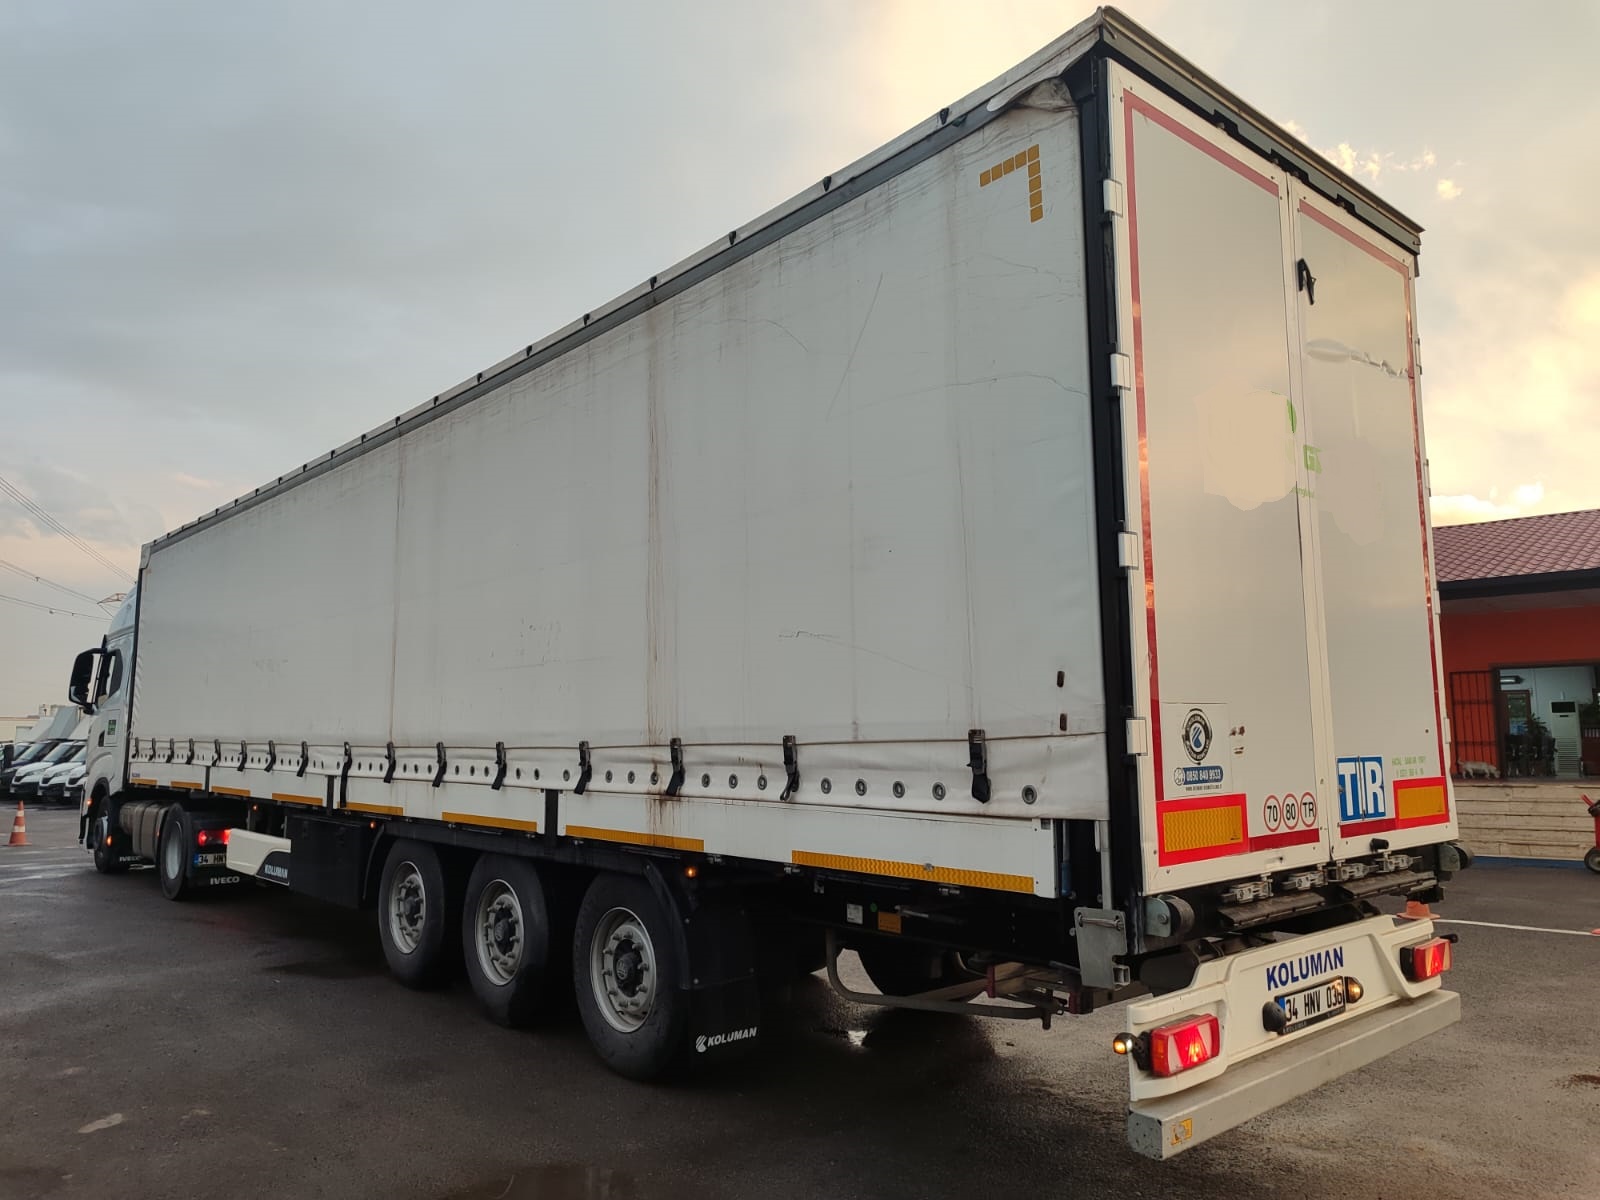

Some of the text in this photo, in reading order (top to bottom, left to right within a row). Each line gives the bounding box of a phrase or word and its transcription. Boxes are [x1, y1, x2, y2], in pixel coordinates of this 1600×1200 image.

[1338, 761, 1385, 817] TIR
[1267, 805, 1278, 823] 70
[1285, 803, 1296, 821] 80
[1303, 801, 1315, 818] TR
[200, 854, 209, 864] 34
[210, 876, 240, 885] IVECO
[1266, 946, 1344, 991] KOLUMAN
[1285, 997, 1298, 1022] 34
[1303, 989, 1321, 1017] HNV
[708, 1027, 757, 1047] KOLUMAN
